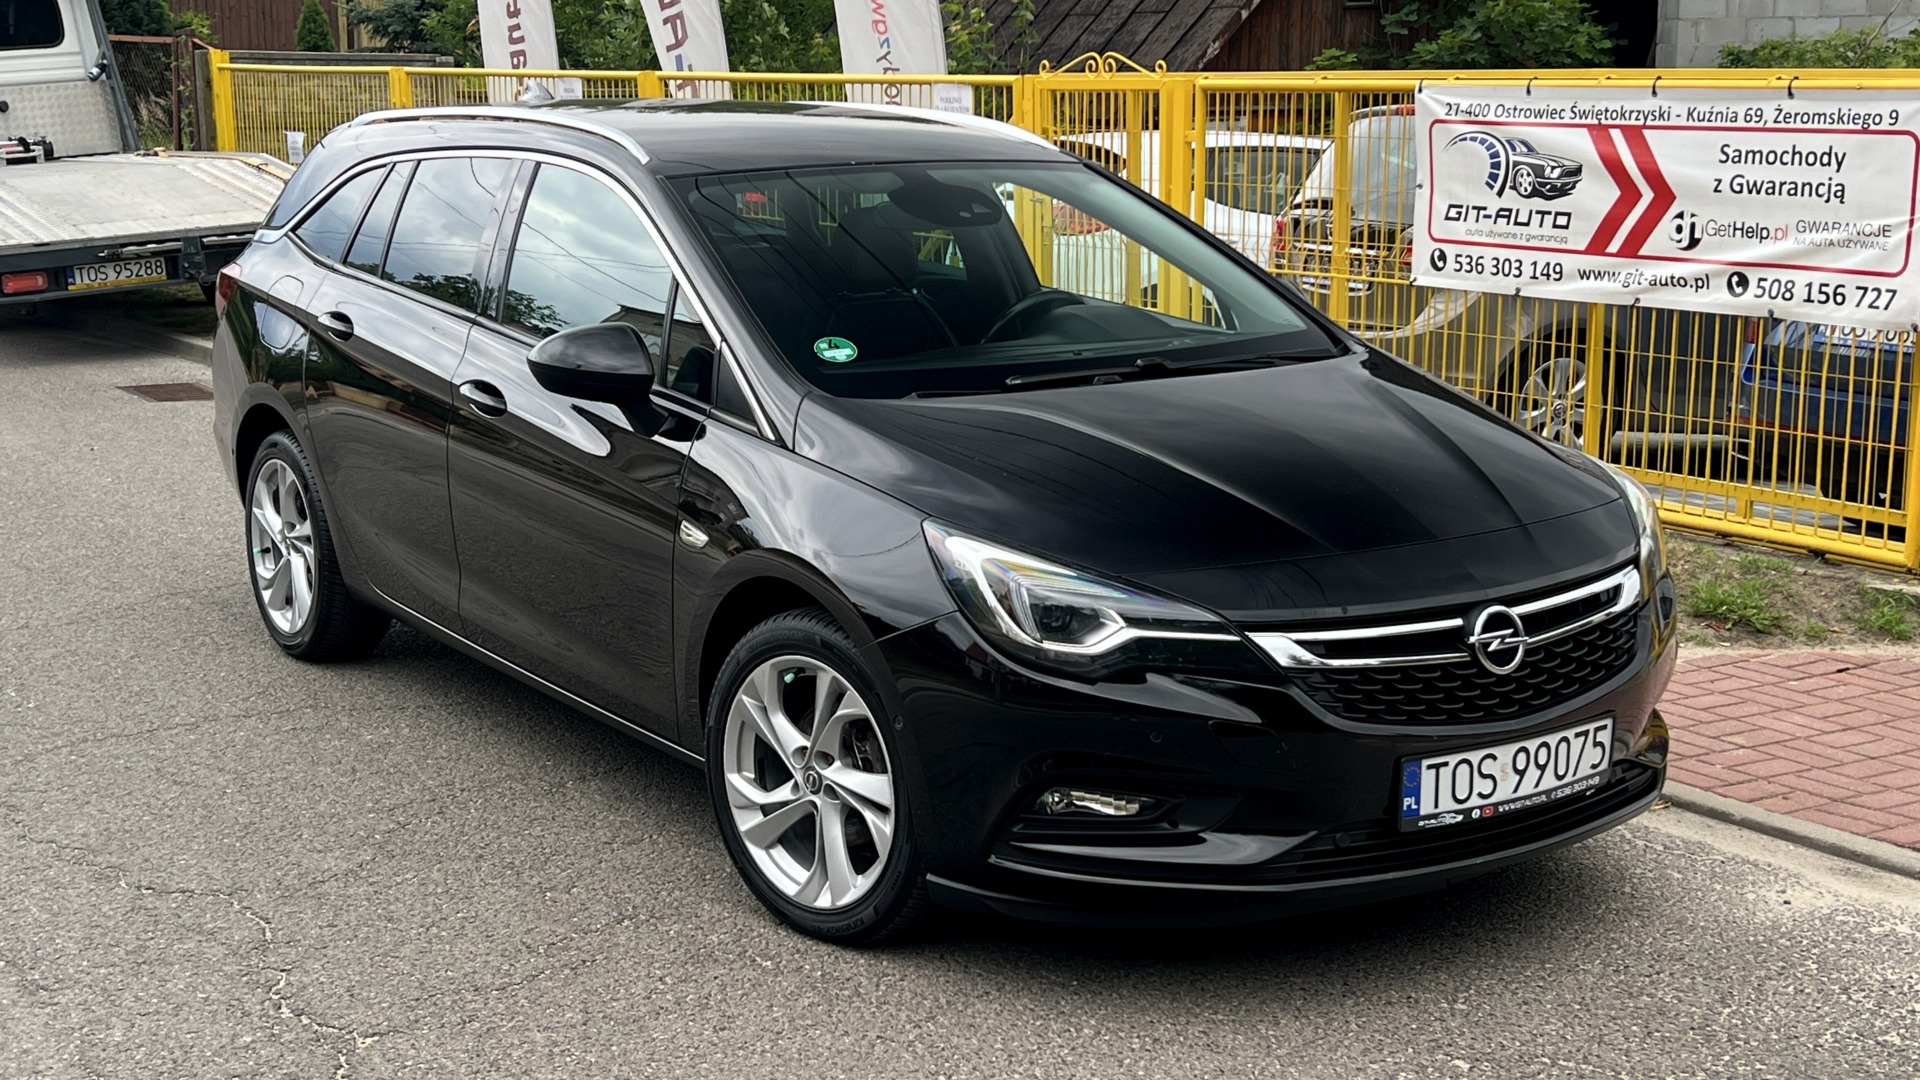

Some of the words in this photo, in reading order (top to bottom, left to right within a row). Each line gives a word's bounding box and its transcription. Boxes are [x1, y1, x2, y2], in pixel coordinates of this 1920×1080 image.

[1445, 102, 1490, 118] 27-400
[1494, 103, 1565, 120] Ostrowiec
[1569, 101, 1670, 126] Świętokrzyski
[1686, 105, 1738, 123] Kuźnia
[1743, 107, 1768, 126] 69,
[1773, 104, 1883, 130] Żeromskiego
[1888, 109, 1900, 126] 9
[1718, 143, 1847, 173] Samochody
[1713, 178, 1723, 193] z
[1729, 173, 1846, 204] Gwarancją
[1443, 203, 1572, 230] GIT-AUTO
[1795, 219, 1892, 238] GWARANCJE
[1465, 228, 1484, 237] auta
[1485, 228, 1518, 241] używane
[1525, 232, 1568, 245] gwarancją
[1705, 219, 1788, 244] GetHelp.pl
[1793, 236, 1807, 246] NA
[1808, 236, 1836, 248] AUTA
[76, 265, 108, 283] TOS
[113, 259, 164, 280] 95288
[1453, 253, 1485, 275] 536
[1490, 256, 1523, 278] 303
[1529, 260, 1563, 282] 149
[1577, 268, 1710, 293] www.git-auto.pl
[1754, 277, 1796, 301] 508
[1802, 280, 1846, 306] 156
[1855, 285, 1898, 311] 727
[1426, 753, 1498, 809] TOS
[1511, 724, 1608, 794] 99075
[1403, 797, 1418, 811] PL
